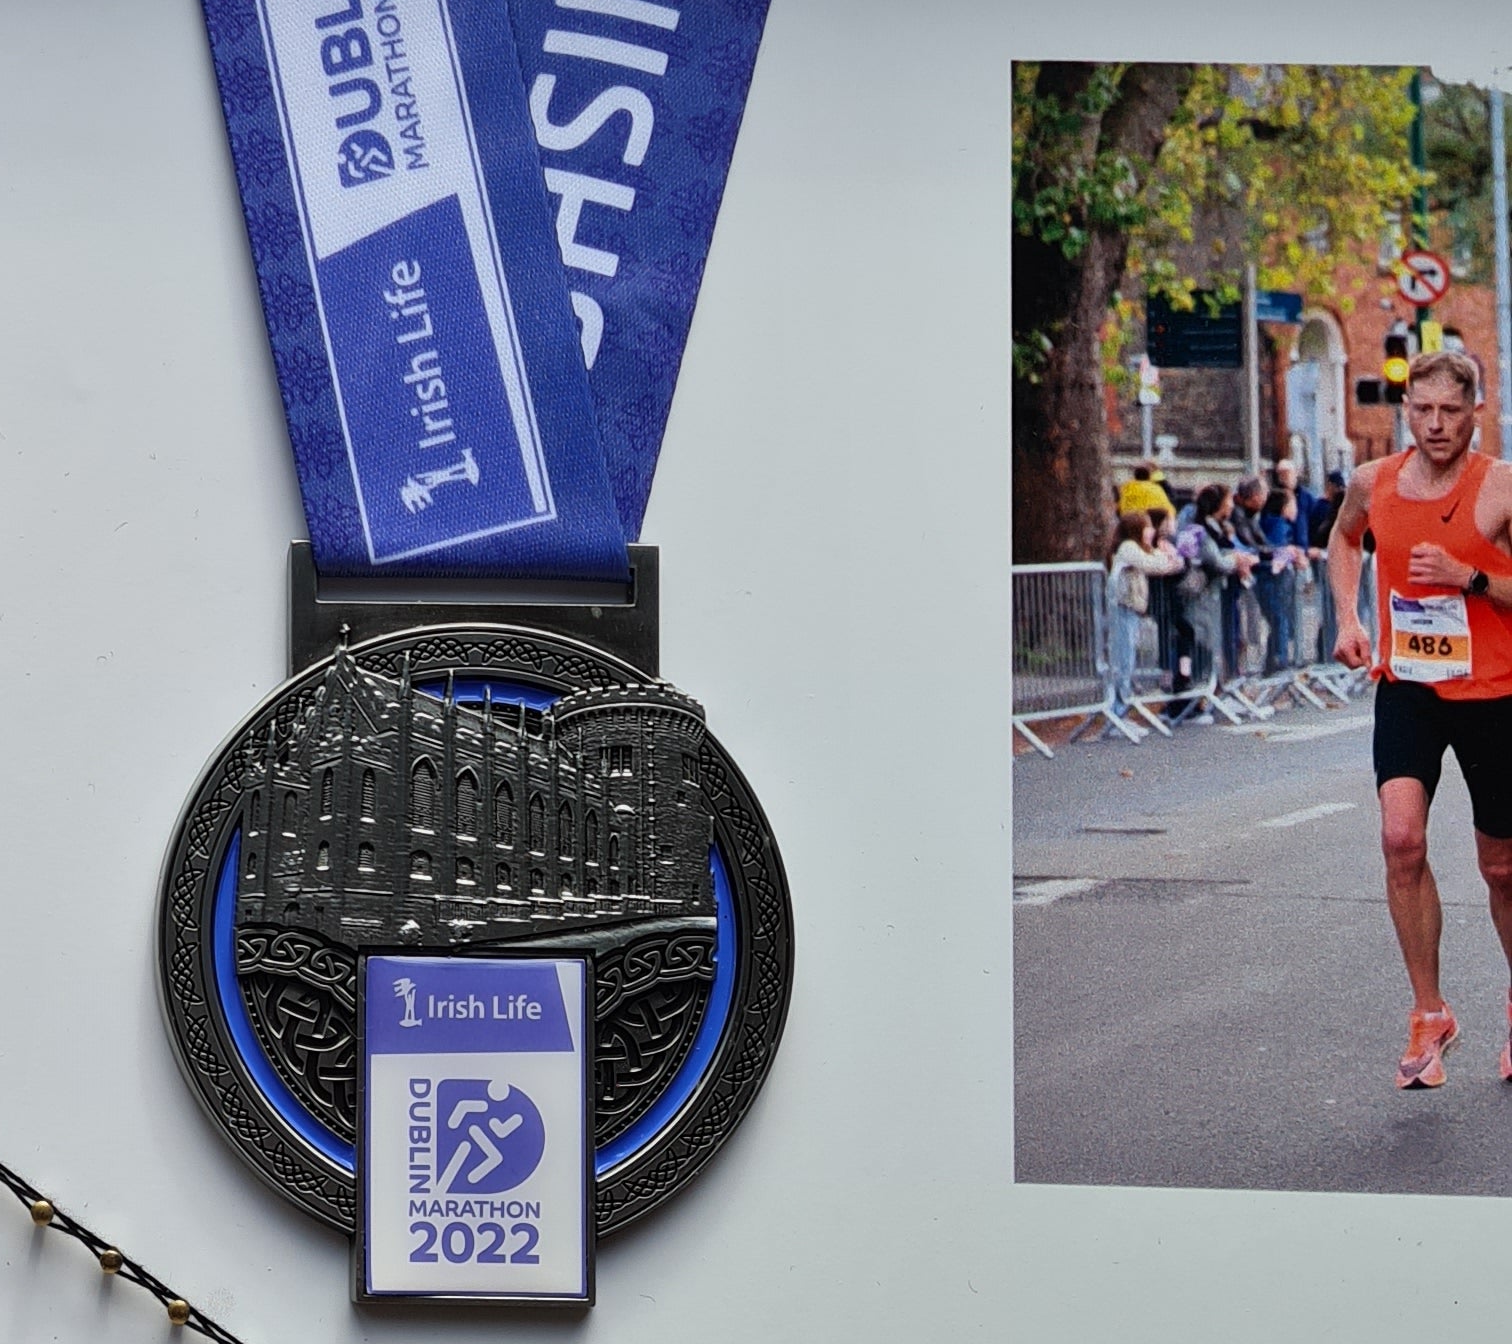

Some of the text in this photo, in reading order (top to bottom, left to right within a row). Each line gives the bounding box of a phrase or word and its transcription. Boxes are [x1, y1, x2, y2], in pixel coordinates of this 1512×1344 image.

[383, 259, 456, 449] Irish Life
[1409, 635, 1453, 656] 486
[428, 994, 542, 1022] Irish Life
[408, 1078, 432, 1194] DUBLIN
[408, 1199, 541, 1219] MARATHON
[409, 1221, 540, 1265] 2022
